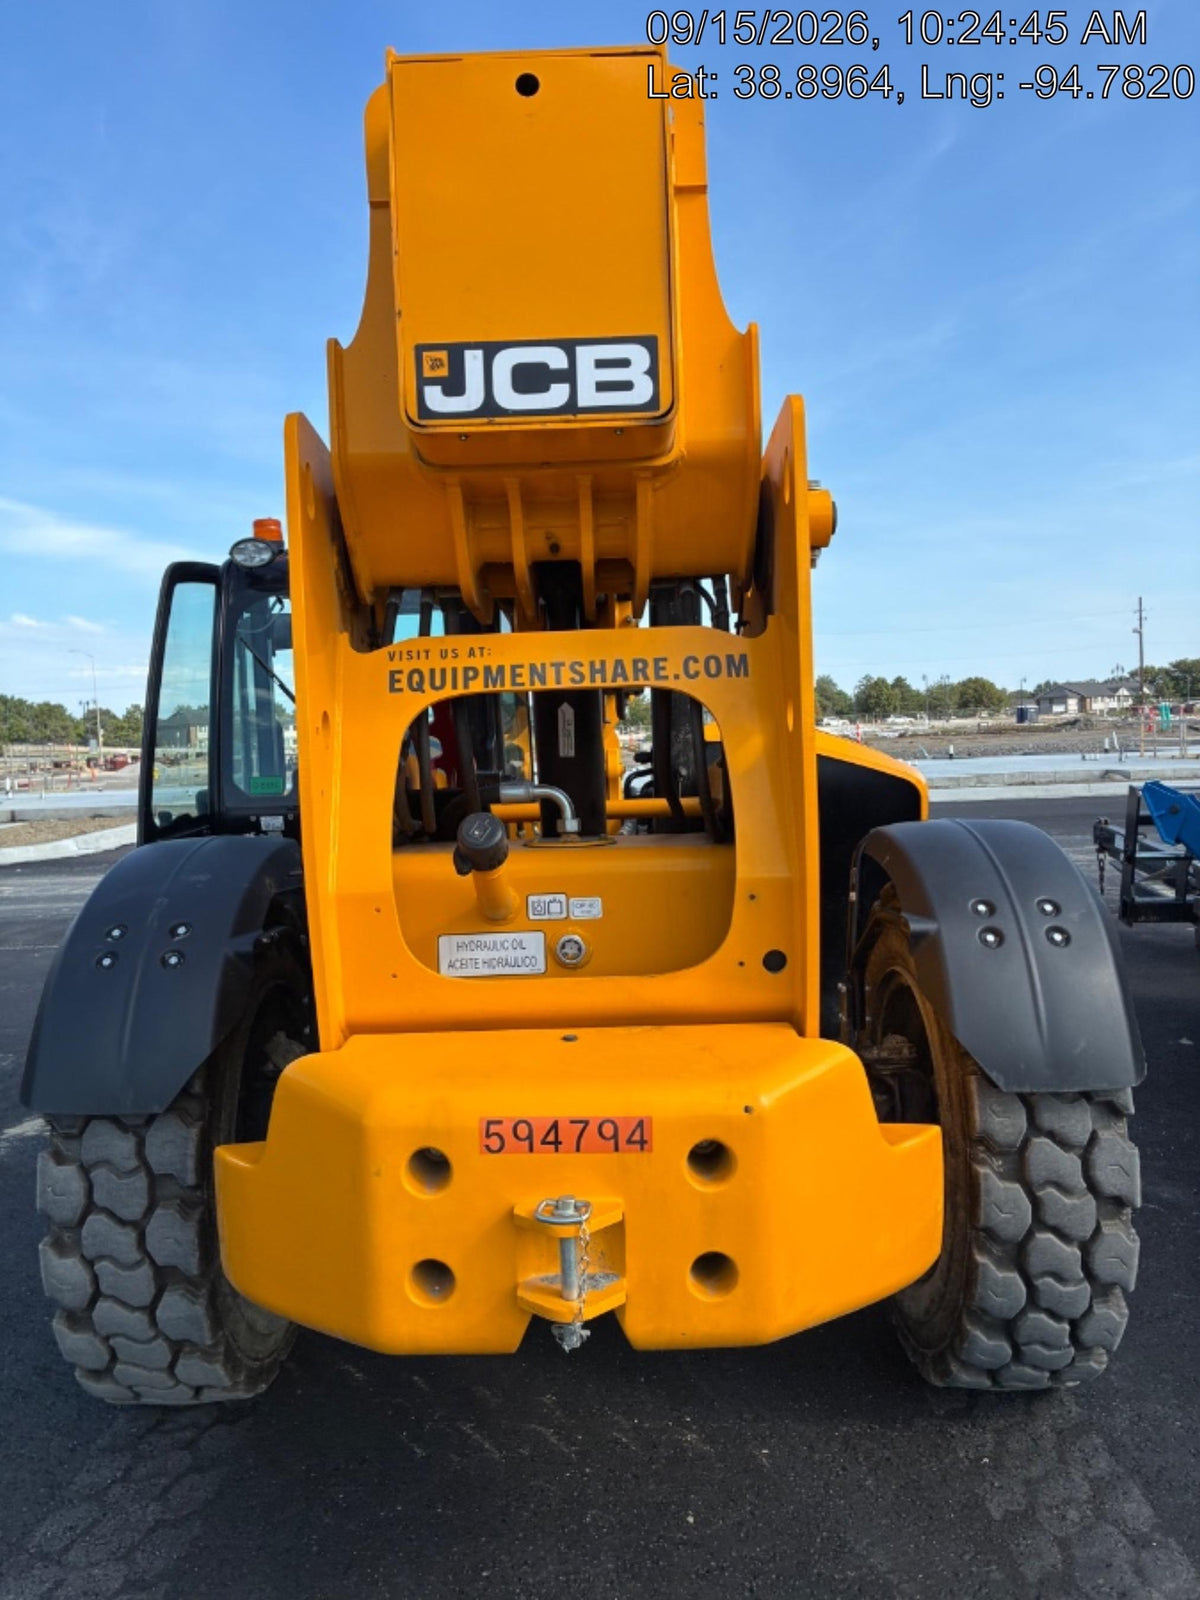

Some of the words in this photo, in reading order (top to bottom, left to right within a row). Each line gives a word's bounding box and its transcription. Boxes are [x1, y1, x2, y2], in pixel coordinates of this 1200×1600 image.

[423, 343, 653, 413] JCB
[387, 649, 431, 662] VISIT
[440, 648, 459, 660] US
[467, 646, 492, 659] AT:
[388, 653, 749, 694] EQUIPMENTSHARE.COM
[456, 939, 509, 952] HYDRAULIC
[511, 938, 527, 951] OIL
[447, 957, 480, 970] ACEITE
[484, 1119, 648, 1154] 594794
